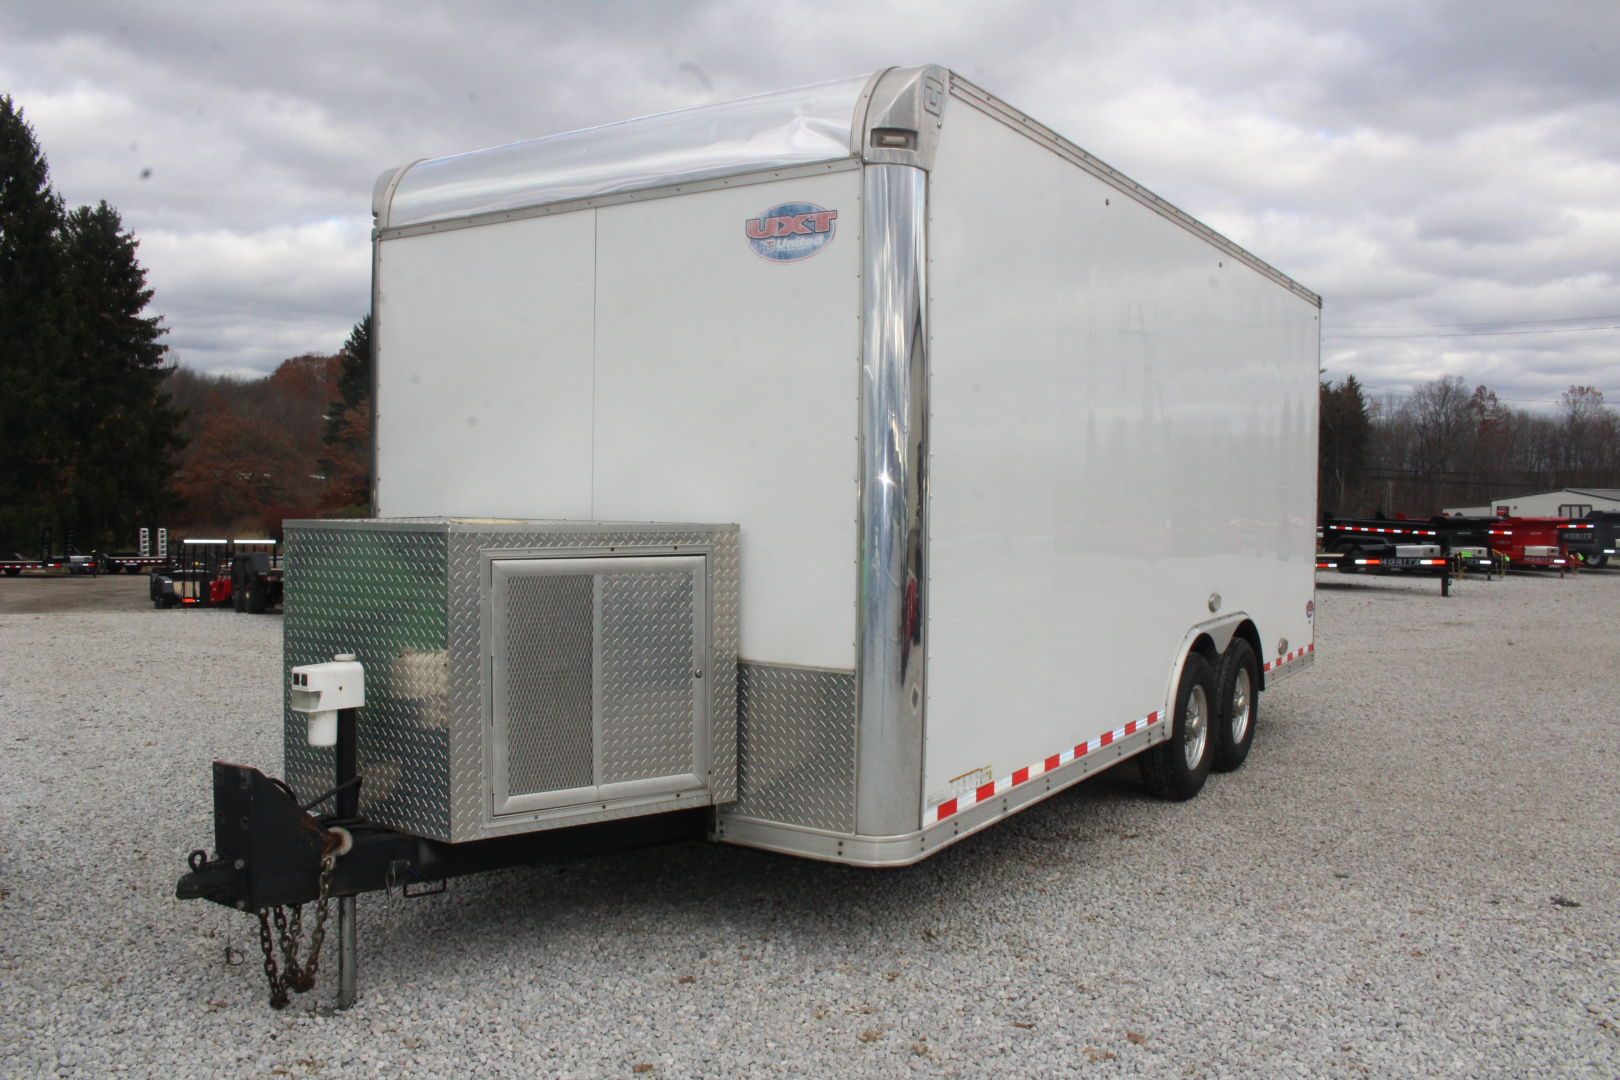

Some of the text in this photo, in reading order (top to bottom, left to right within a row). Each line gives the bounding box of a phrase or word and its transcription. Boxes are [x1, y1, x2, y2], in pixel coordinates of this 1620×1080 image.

[746, 210, 838, 239] UXT
[776, 235, 824, 249] United
[1562, 532, 1593, 540] MORITZ
[1379, 558, 1421, 566] MORITZ
